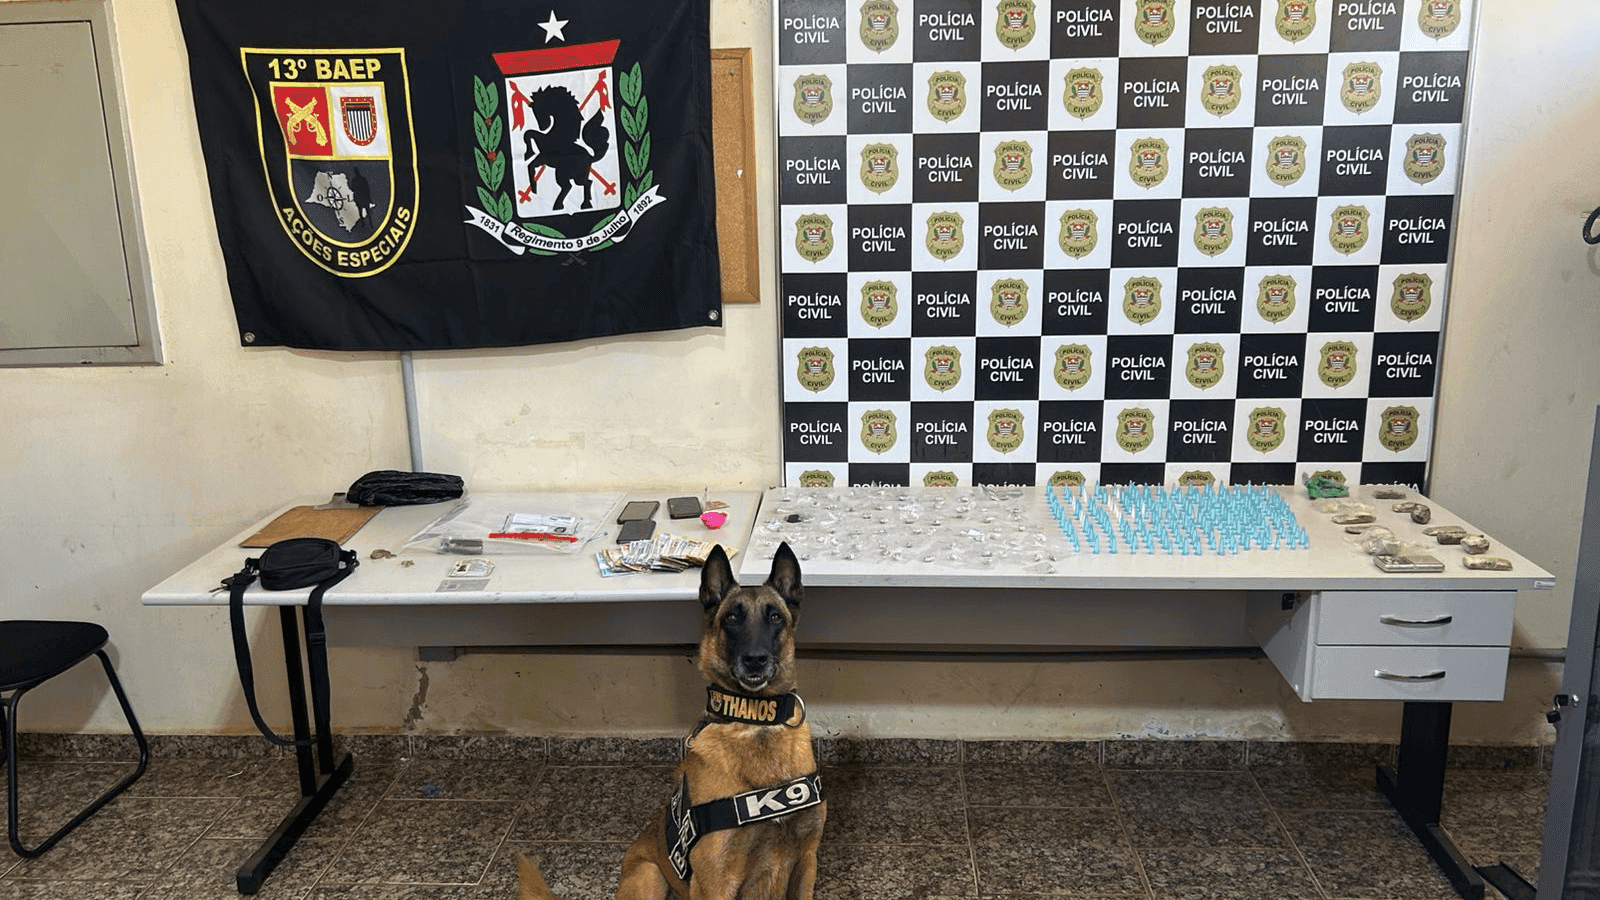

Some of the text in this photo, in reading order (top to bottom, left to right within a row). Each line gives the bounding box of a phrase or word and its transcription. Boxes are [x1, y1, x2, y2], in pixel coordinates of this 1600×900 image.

[1197, 3, 1253, 18] POLÍCIA
[1338, 0, 1396, 15] POLÍCIA
[920, 11, 974, 26] POLÍCIA
[1057, 7, 1113, 23] POLÍCIA
[784, 15, 839, 29] POLÍCIA
[1207, 21, 1242, 33] CIVIL
[1348, 18, 1384, 30] CIVIL
[795, 31, 829, 43] CIVIL
[929, 29, 964, 40] CIVIL
[1067, 25, 1102, 37] CIVIL
[268, 58, 381, 80] 13º BAEP
[1124, 79, 1179, 93] POLÍCIA
[1263, 76, 1319, 91] POLÍCIA
[1403, 73, 1461, 88] POLÍCIA
[852, 85, 906, 99] POLÍCIA
[987, 82, 1042, 96] POLÍCIA
[1134, 96, 1168, 107] CIVIL
[1272, 93, 1307, 105] CIVIL
[1413, 90, 1448, 102] CIVIL
[862, 102, 896, 113] CIVIL
[997, 99, 1031, 110] CIVIL
[1053, 152, 1108, 166] POLÍCIA
[1190, 149, 1245, 163] POLÍCIA
[1327, 147, 1383, 161] POLÍCIA
[787, 157, 840, 171] POLÍCIA
[919, 154, 972, 168] POLÍCIA
[1063, 168, 1097, 179] CIVIL
[1199, 166, 1233, 177] CIVIL
[1337, 164, 1371, 175] CIVIL
[797, 173, 830, 184] CIVIL
[929, 171, 962, 182] CIVIL
[479, 195, 653, 250] 1831 Regimento 9 de Julho 1892
[1119, 220, 1172, 234] POLÍCIA
[1254, 218, 1308, 232] POLÍCIA
[1390, 217, 1445, 230] POLÍCIA
[853, 225, 905, 238] POLÍCIA
[985, 223, 1038, 236] POLÍCIA
[282, 206, 411, 268] AÇÕES ESPECIAIS
[1128, 237, 1162, 247] CIVIL
[1263, 235, 1297, 245] CIVIL
[1399, 233, 1433, 243] CIVIL
[863, 241, 895, 251] CIVIL
[994, 239, 1027, 249] CIVIL
[918, 291, 970, 304] POLÍCIA
[1049, 289, 1102, 302] POLÍCIA
[1183, 287, 1236, 300] POLÍCIA
[1317, 286, 1370, 299] POLÍCIA
[789, 293, 841, 306] POLÍCIA
[799, 308, 831, 318] CIVIL
[927, 307, 960, 317] CIVIL
[1058, 305, 1091, 315] CIVIL
[1192, 304, 1225, 314] CIVIL
[1326, 302, 1359, 312] CIVIL
[854, 357, 904, 370] POLÍCIA
[981, 356, 1033, 369] POLÍCIA
[1112, 354, 1165, 367] POLÍCIA
[1245, 353, 1297, 366] POLÍCIA
[1378, 352, 1432, 365] POLÍCIA
[863, 373, 894, 382] CIVIL
[991, 372, 1023, 381] CIVIL
[1122, 370, 1154, 380] CIVIL
[1254, 369, 1287, 379] CIVIL
[1387, 368, 1420, 377] CIVIL
[791, 419, 842, 432] POLÍCIA
[917, 419, 967, 432] POLÍCIA
[1044, 418, 1096, 431] POLÍCIA
[1174, 418, 1226, 431] POLÍCIA
[1306, 417, 1358, 430] POLÍCIA
[801, 435, 832, 444] CIVIL
[926, 435, 957, 444] CIVIL
[1053, 434, 1085, 444] CIVIL
[1183, 434, 1215, 443] CIVIL
[1314, 433, 1347, 443] CIVIL
[723, 694, 777, 721] THANOS
[745, 783, 811, 818] K9
